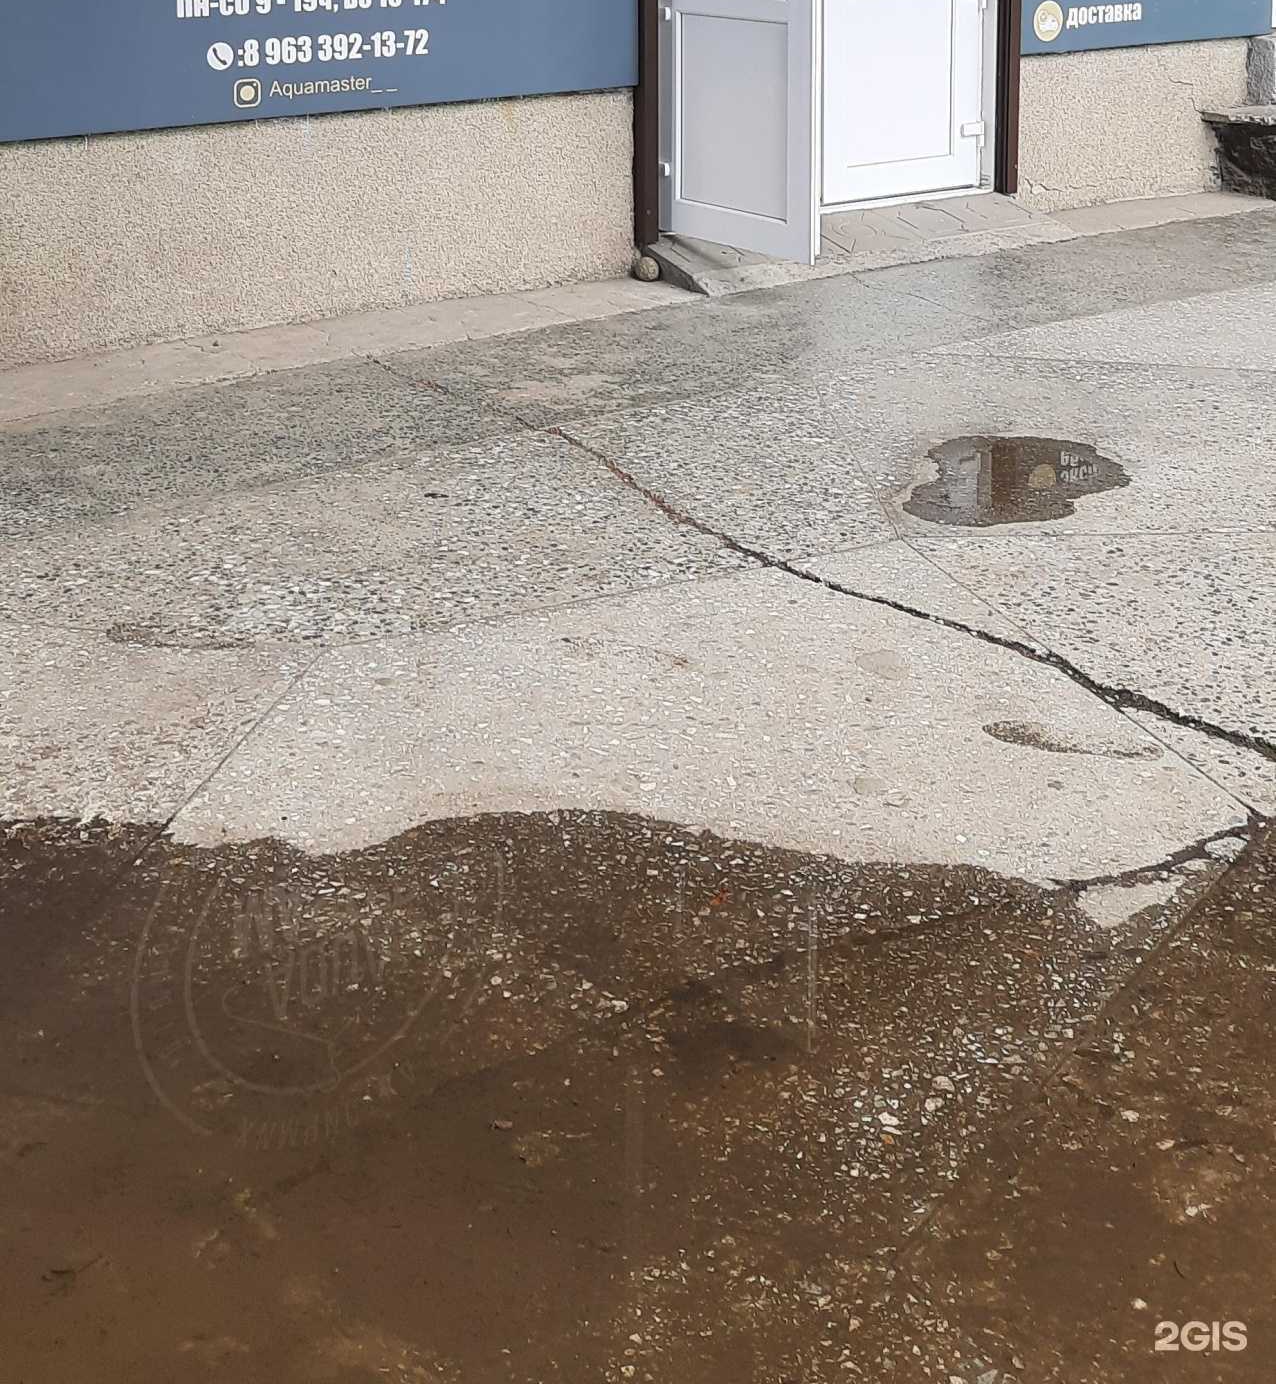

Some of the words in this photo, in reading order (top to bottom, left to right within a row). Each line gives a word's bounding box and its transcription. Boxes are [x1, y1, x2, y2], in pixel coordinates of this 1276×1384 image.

[1067, 3, 1141, 29] доставка
[265, 36, 312, 64] 963
[318, 29, 428, 60] 392-13-72
